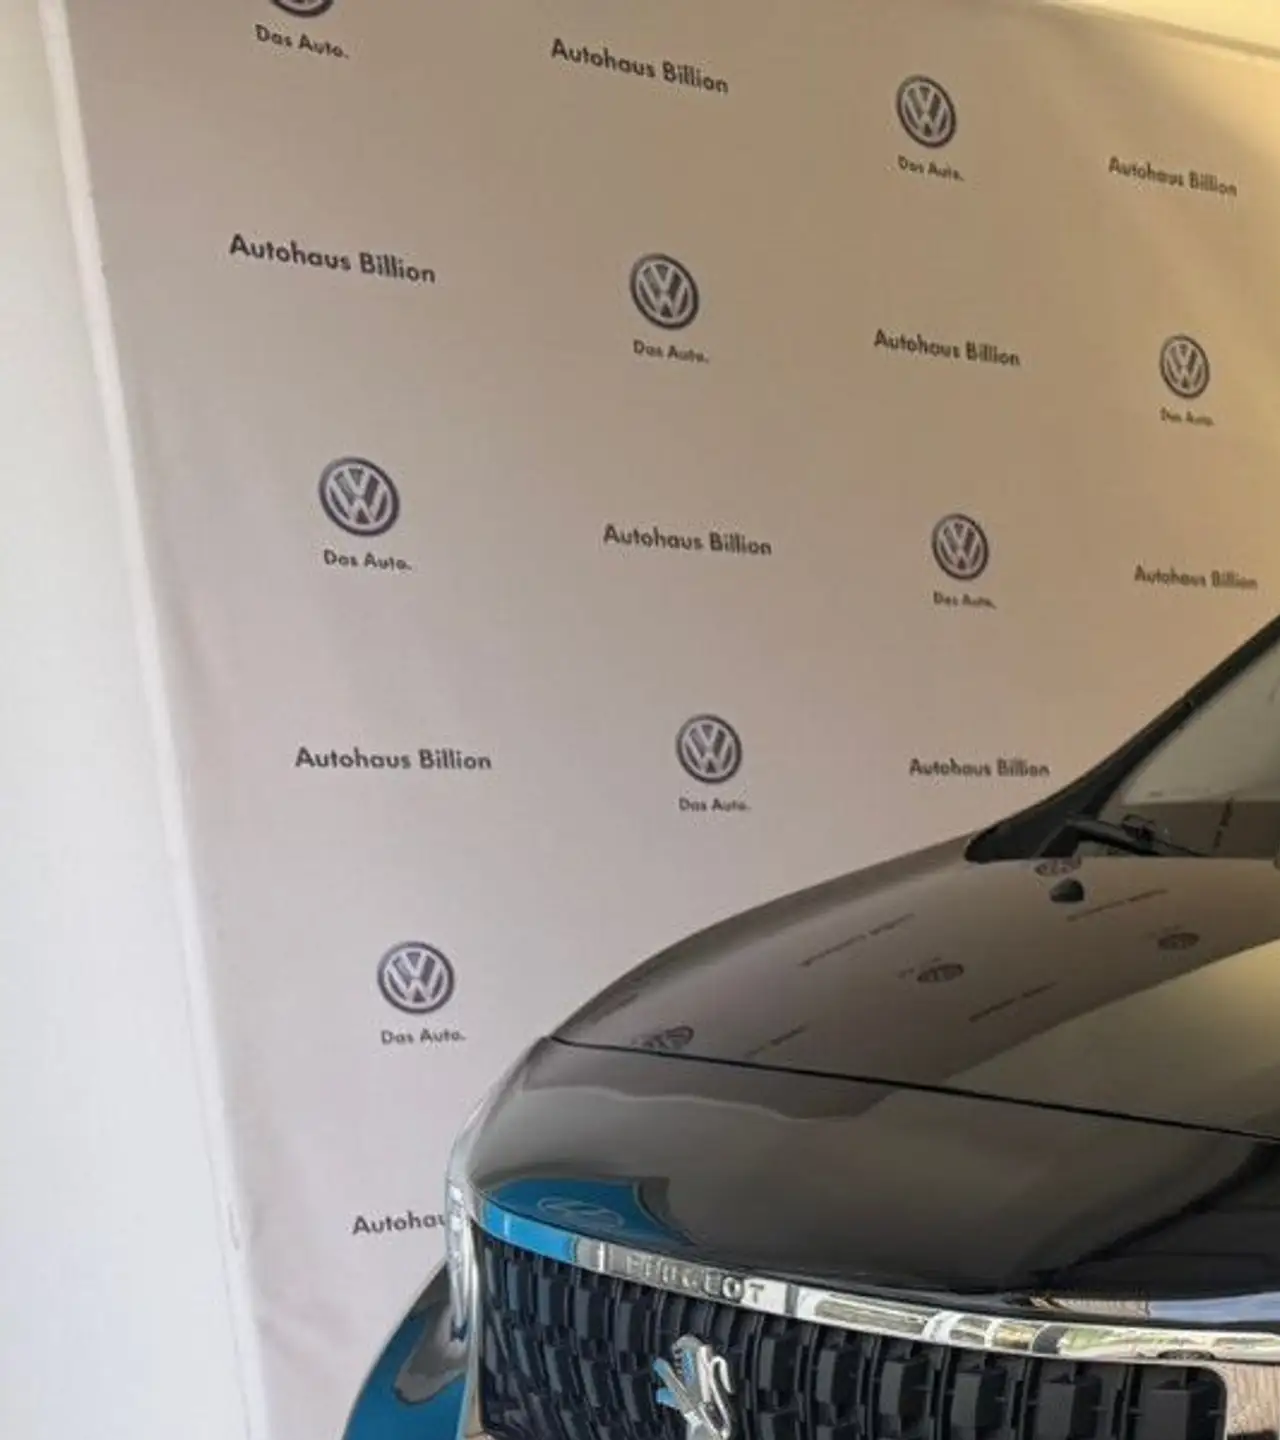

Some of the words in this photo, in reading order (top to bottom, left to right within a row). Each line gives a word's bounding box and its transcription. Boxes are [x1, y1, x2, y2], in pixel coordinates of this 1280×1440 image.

[255, 24, 293, 48] Das
[298, 32, 350, 59] Auto.
[551, 38, 656, 79] Autohaus
[662, 61, 729, 94] Billion
[898, 155, 928, 176] Das
[931, 162, 965, 182] Auto.
[1108, 156, 1185, 188] Autohaus
[1188, 170, 1238, 197] Billion
[229, 233, 352, 272] Autohaus
[359, 250, 437, 284] Billion
[633, 339, 664, 359] Das
[667, 345, 710, 364] Auto.
[874, 328, 961, 360] Autohaus
[966, 340, 1021, 367] Billion
[603, 523, 704, 552] Autohaus
[709, 532, 772, 556] Billion
[323, 548, 359, 568] Das
[364, 551, 412, 571] Auto.
[1134, 564, 1207, 588] Autohaus
[1210, 570, 1258, 590] Billion
[933, 590, 959, 607] Das
[961, 593, 996, 609] Auto.
[295, 746, 412, 770] Autohaus
[418, 747, 492, 771] Billion
[909, 757, 992, 777] Autohaus
[996, 758, 1050, 778] Billion
[678, 797, 708, 813] Das
[711, 797, 751, 813] Auto.
[381, 1030, 415, 1046] Das
[419, 1027, 466, 1045] Auto.
[352, 1209, 447, 1236] Autohau
